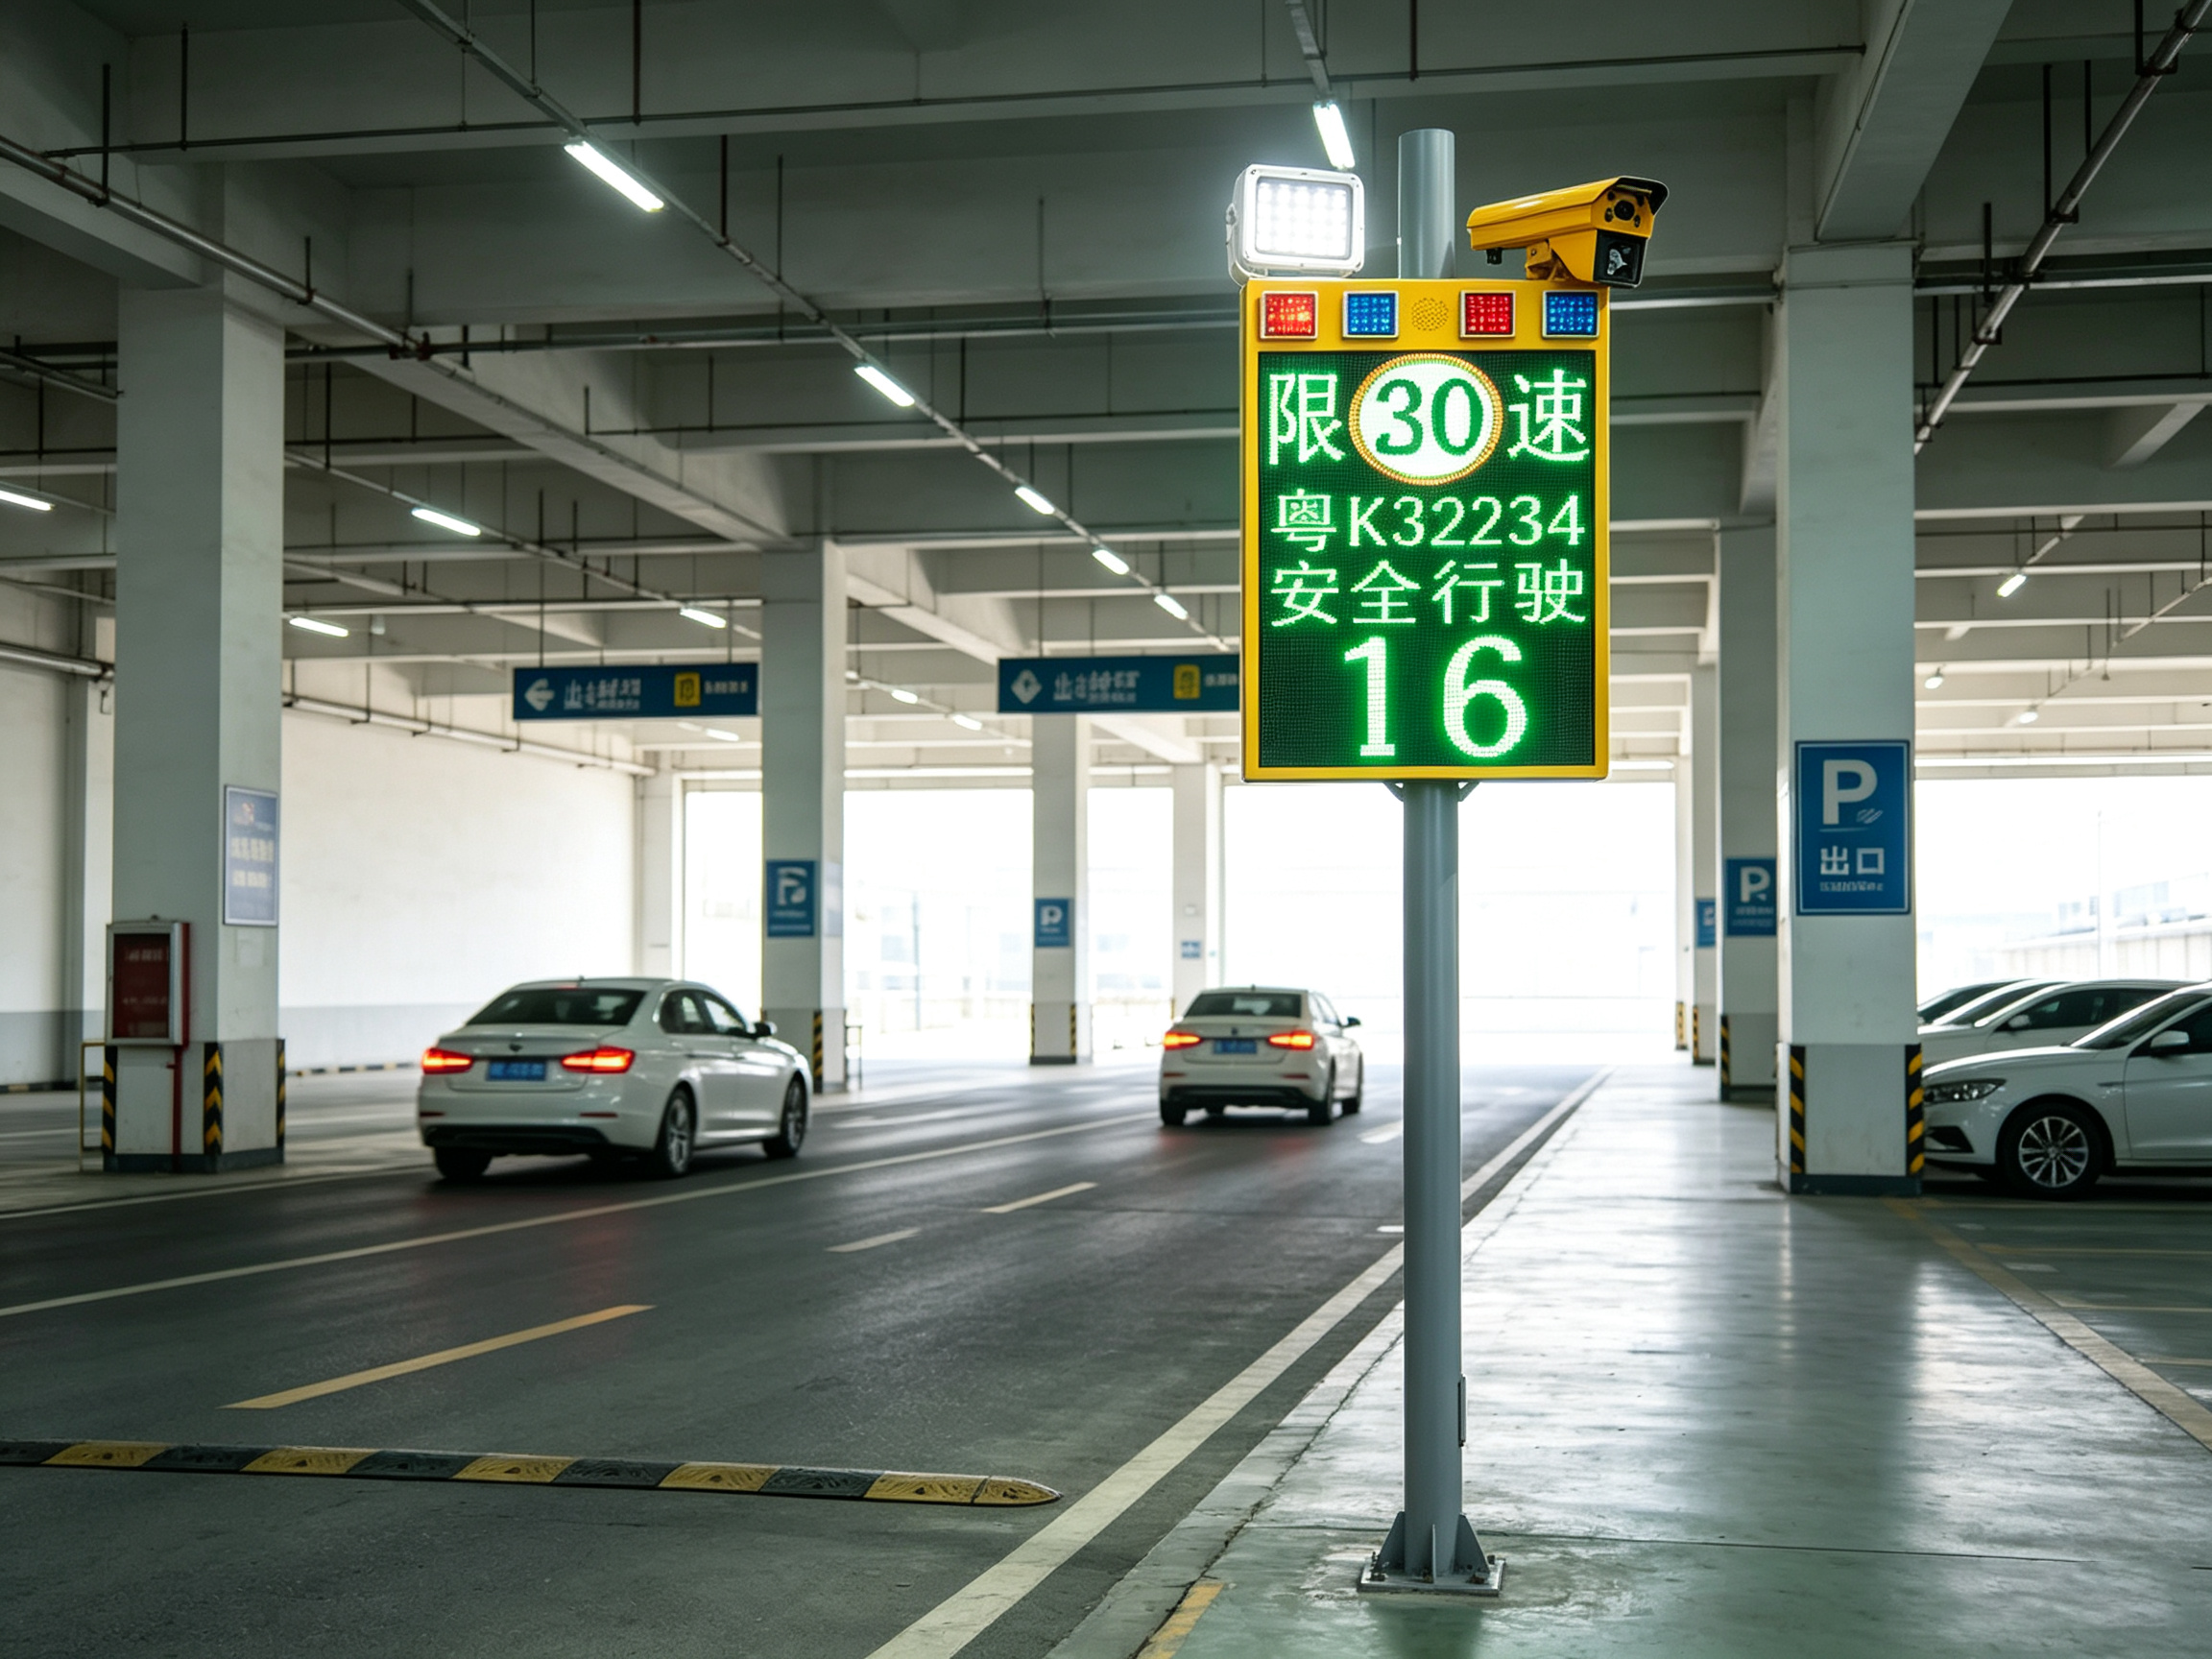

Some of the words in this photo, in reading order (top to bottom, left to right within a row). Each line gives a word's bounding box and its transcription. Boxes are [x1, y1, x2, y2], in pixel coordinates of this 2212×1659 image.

[1268, 373, 1346, 465] 限
[1375, 377, 1484, 457] 30
[1507, 369, 1590, 462] 速
[1270, 559, 1587, 627] 安全行驶
[1343, 635, 1528, 757] 16
[1823, 759, 1878, 825] P
[1741, 866, 1770, 902] P
[1820, 846, 1885, 876] 出口
